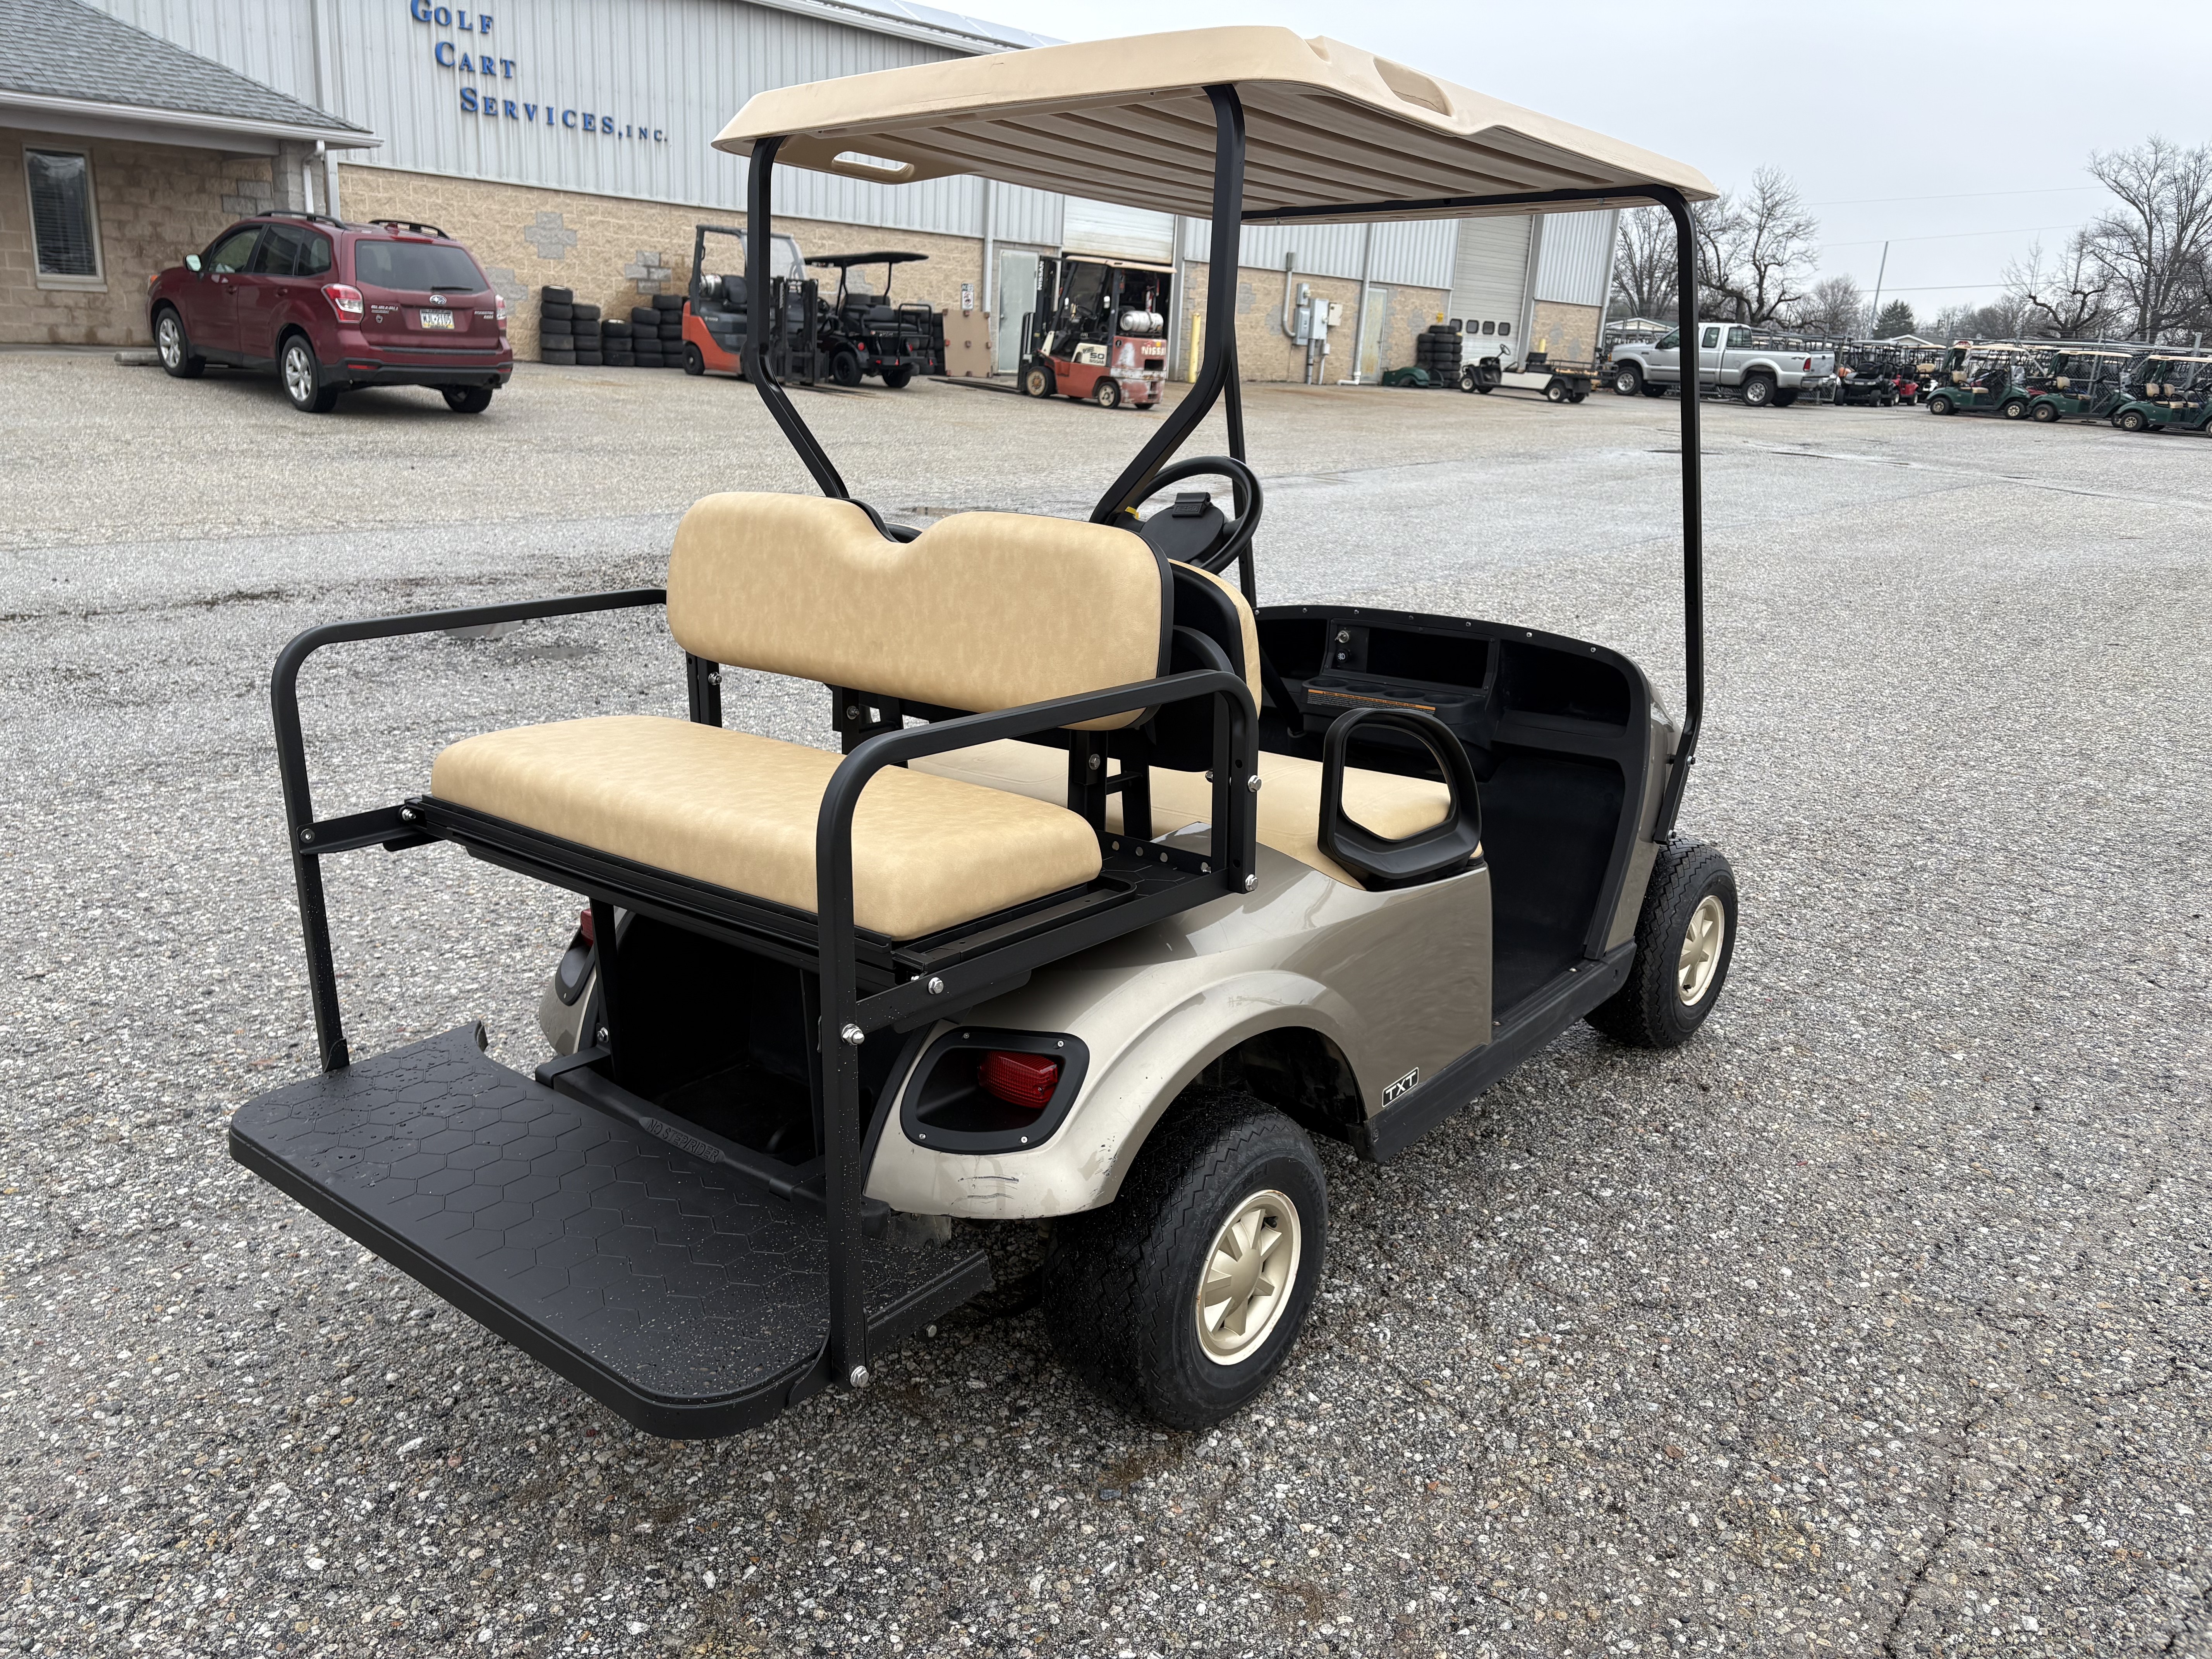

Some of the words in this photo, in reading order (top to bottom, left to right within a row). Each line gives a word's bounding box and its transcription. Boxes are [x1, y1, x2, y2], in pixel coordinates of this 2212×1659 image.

[410, 0, 493, 34] GOLF
[435, 41, 515, 79] CART
[626, 125, 668, 142] INC.
[1141, 346, 1166, 356] NISSA
[1386, 1071, 1417, 1100] TXT
[646, 1119, 663, 1135] NO
[662, 1127, 719, 1162] STEP/RIDER
